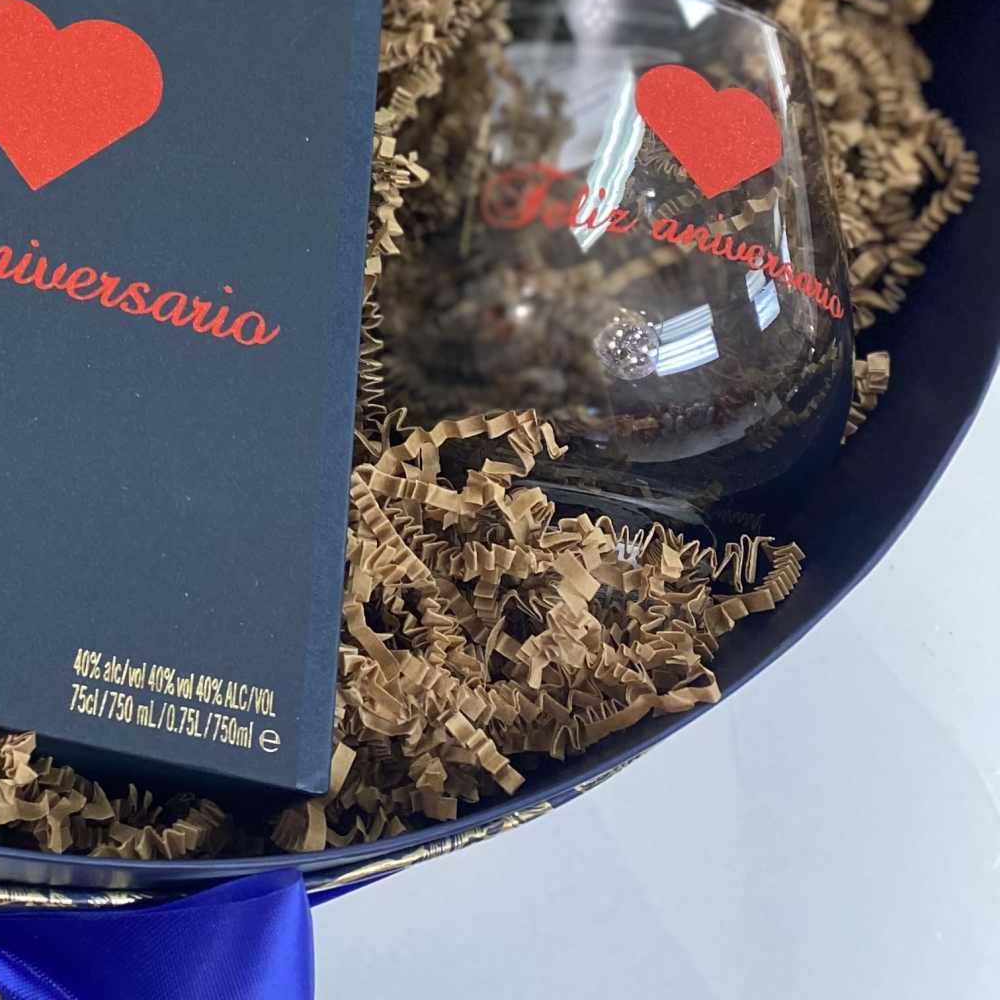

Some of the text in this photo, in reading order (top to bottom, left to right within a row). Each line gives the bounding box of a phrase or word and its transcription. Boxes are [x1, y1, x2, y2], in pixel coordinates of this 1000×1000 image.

[479, 162, 640, 233] Feliz
[73, 648, 277, 718] 40% alc/vol 40% vol 40% ALC/VOL
